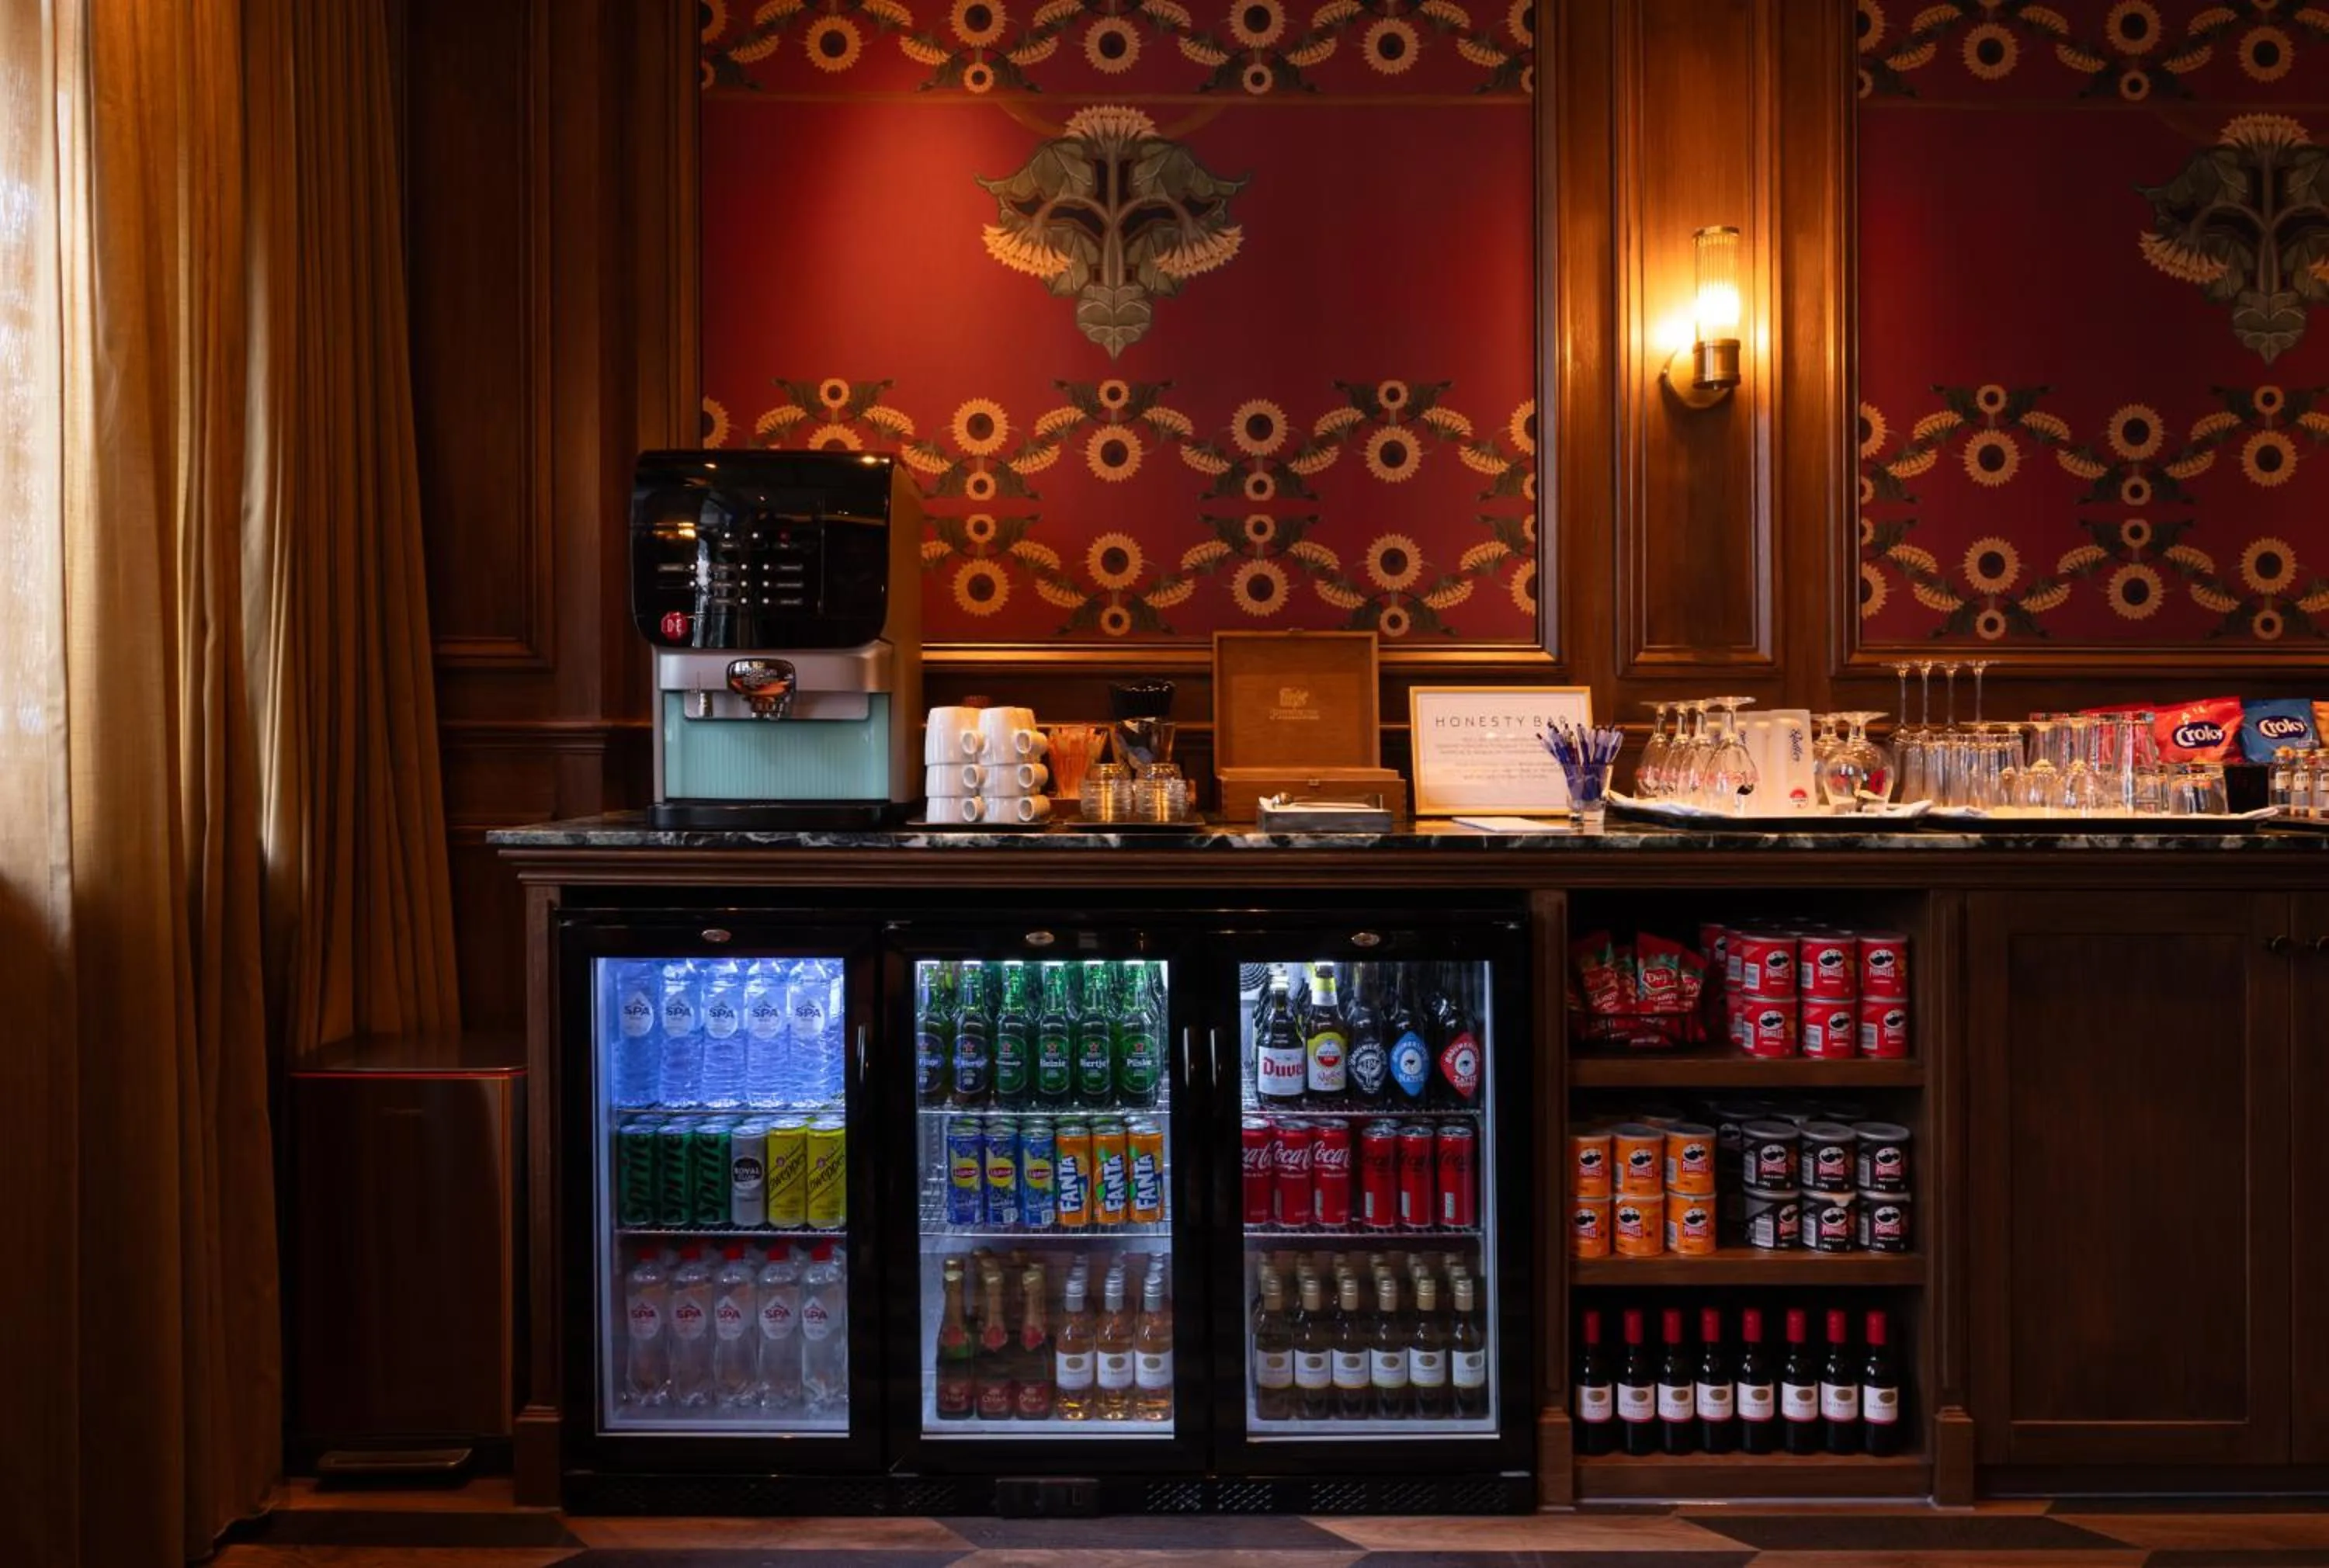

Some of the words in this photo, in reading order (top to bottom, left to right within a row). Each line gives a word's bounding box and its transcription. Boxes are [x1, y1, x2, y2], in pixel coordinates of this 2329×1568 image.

[1435, 716, 1525, 727] HONESTY
[2258, 719, 2305, 737] Croky
[2176, 727, 2223, 747] Croky
[623, 1004, 650, 1016] SPA
[665, 1005, 691, 1016] SPA
[709, 1008, 734, 1019] SPA
[751, 1008, 779, 1018] SPA
[795, 1008, 821, 1018] SPA
[1058, 1155, 1081, 1211] FANTA
[1104, 1155, 1125, 1211] FANTA
[1134, 1155, 1158, 1210] FANTA
[631, 1309, 655, 1318] SPA
[676, 1308, 702, 1318] SPA
[717, 1309, 741, 1319] SPA
[765, 1308, 791, 1318] SPA
[804, 1308, 828, 1319] SPA
